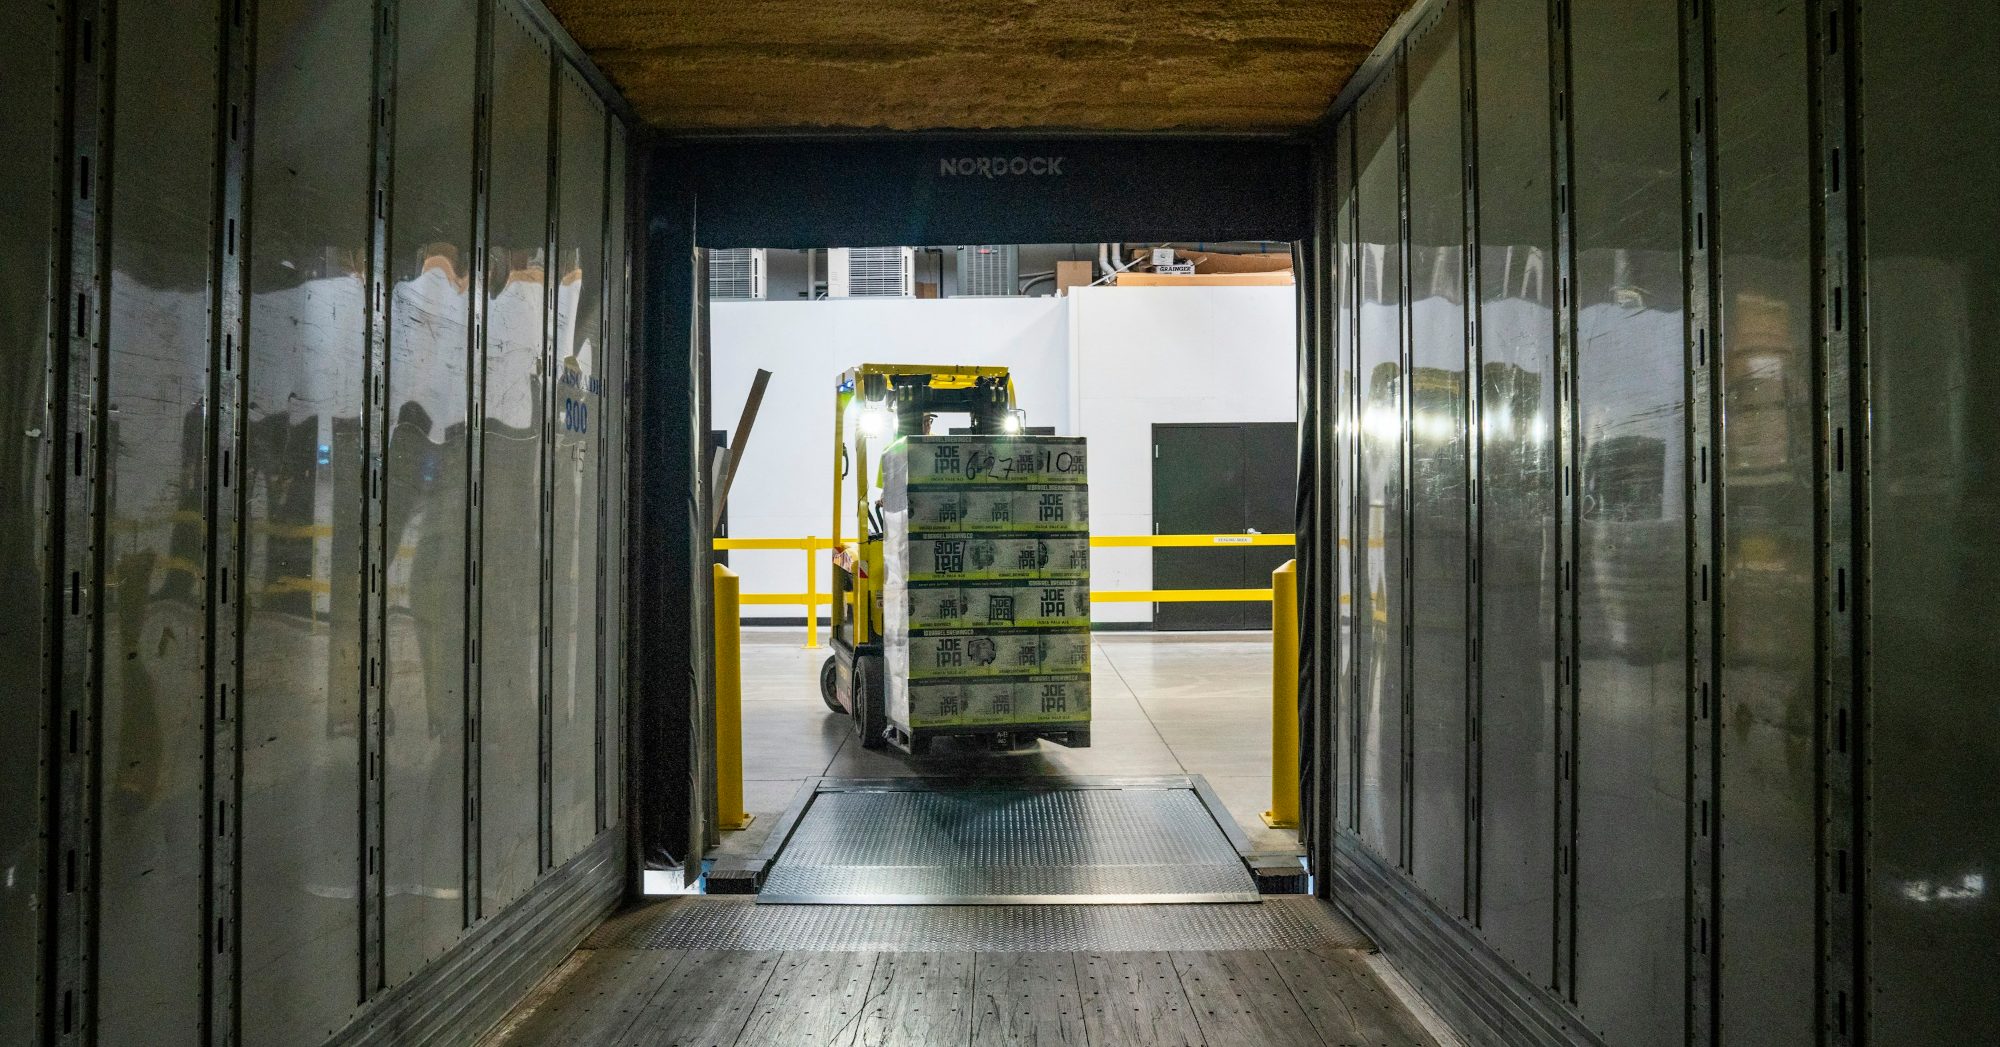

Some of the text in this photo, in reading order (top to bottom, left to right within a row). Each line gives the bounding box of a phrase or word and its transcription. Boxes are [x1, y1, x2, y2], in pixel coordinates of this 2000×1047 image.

[940, 156, 1063, 178] NORDOCK
[565, 398, 587, 434] 800
[935, 446, 959, 457] JOE
[1017, 454, 1034, 463] JOE
[935, 459, 960, 473] IPA
[1017, 464, 1034, 473] IPA
[1040, 494, 1063, 505] JOE
[939, 512, 956, 522] IPA
[992, 512, 1008, 522] IPA
[1040, 507, 1064, 521] IPA
[935, 541, 961, 554] JOE
[1019, 550, 1035, 558] JOE
[1071, 550, 1087, 558] JOE
[935, 555, 961, 571] IPA
[1019, 560, 1035, 569] IPA
[1070, 560, 1087, 569] IPA
[1041, 589, 1064, 601] JOE
[940, 600, 957, 608] JOE
[992, 600, 1009, 608] JOE
[940, 609, 957, 619] IPA
[992, 609, 1009, 619] IPA
[1041, 602, 1065, 617] IPA
[937, 639, 961, 651] JOE
[1019, 646, 1035, 654] JOE
[937, 652, 961, 667] IPA
[1019, 656, 1036, 666] IPA
[1042, 685, 1065, 696] JOE
[1042, 697, 1065, 712] IPA
[941, 706, 958, 716] IPA
